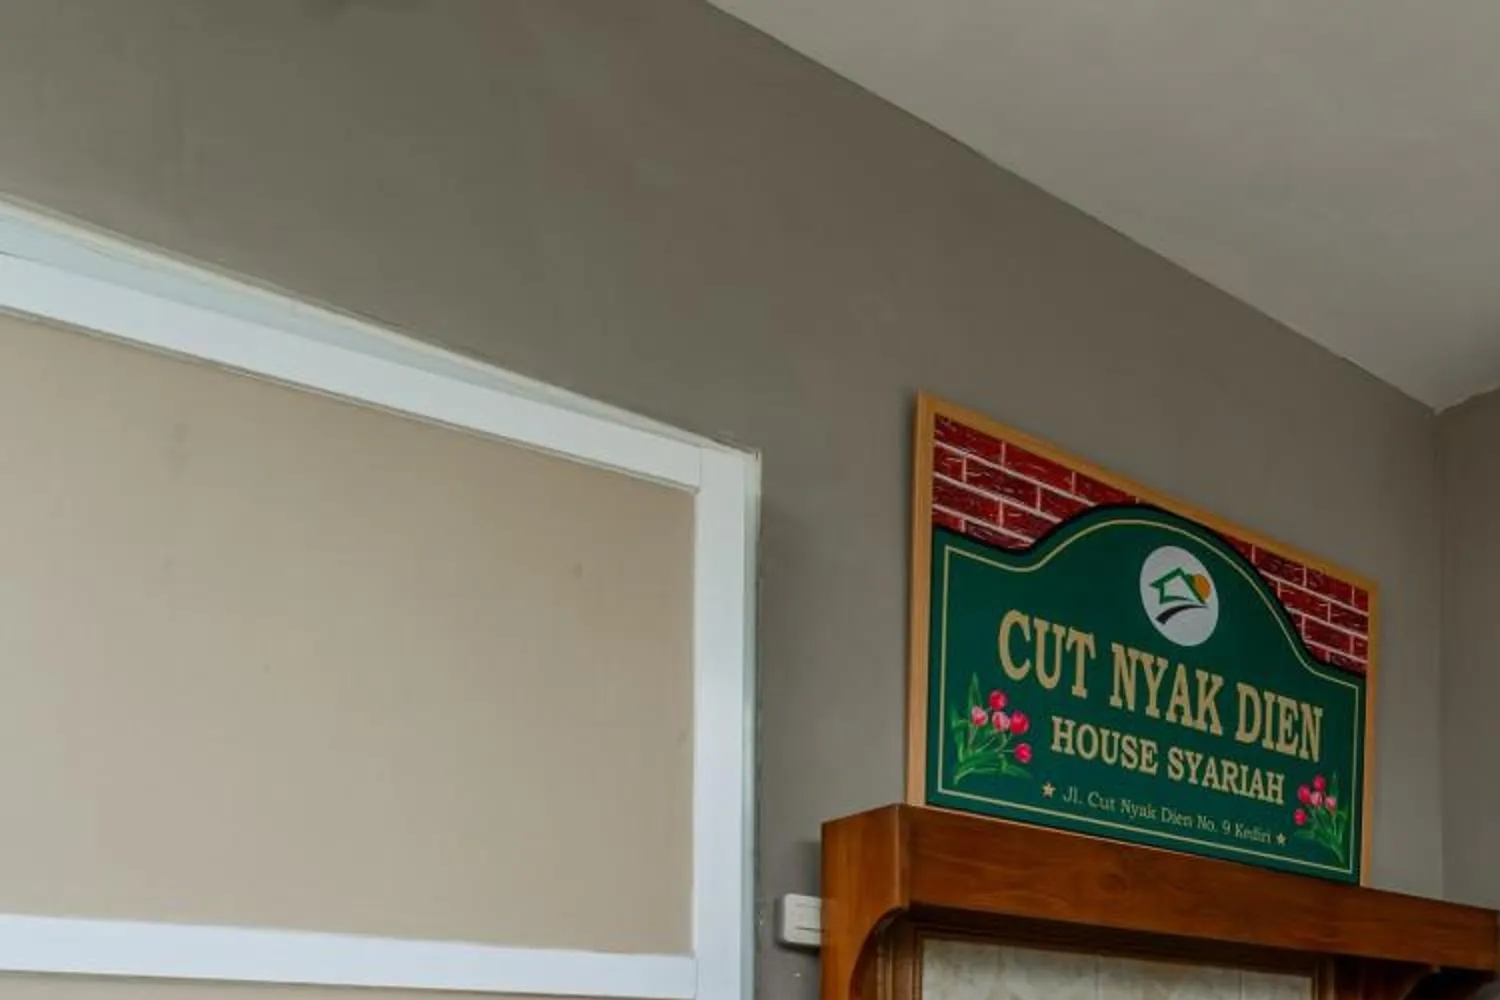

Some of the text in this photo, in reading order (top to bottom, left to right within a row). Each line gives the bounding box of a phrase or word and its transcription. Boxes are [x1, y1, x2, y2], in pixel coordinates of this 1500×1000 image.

[998, 609, 1324, 764] CUT NYAK DIEN
[1050, 715, 1286, 806] HOUSE SYARIAH
[1063, 785, 1271, 845] Jl. Cut Nyak Dien No. 9 Kediri
